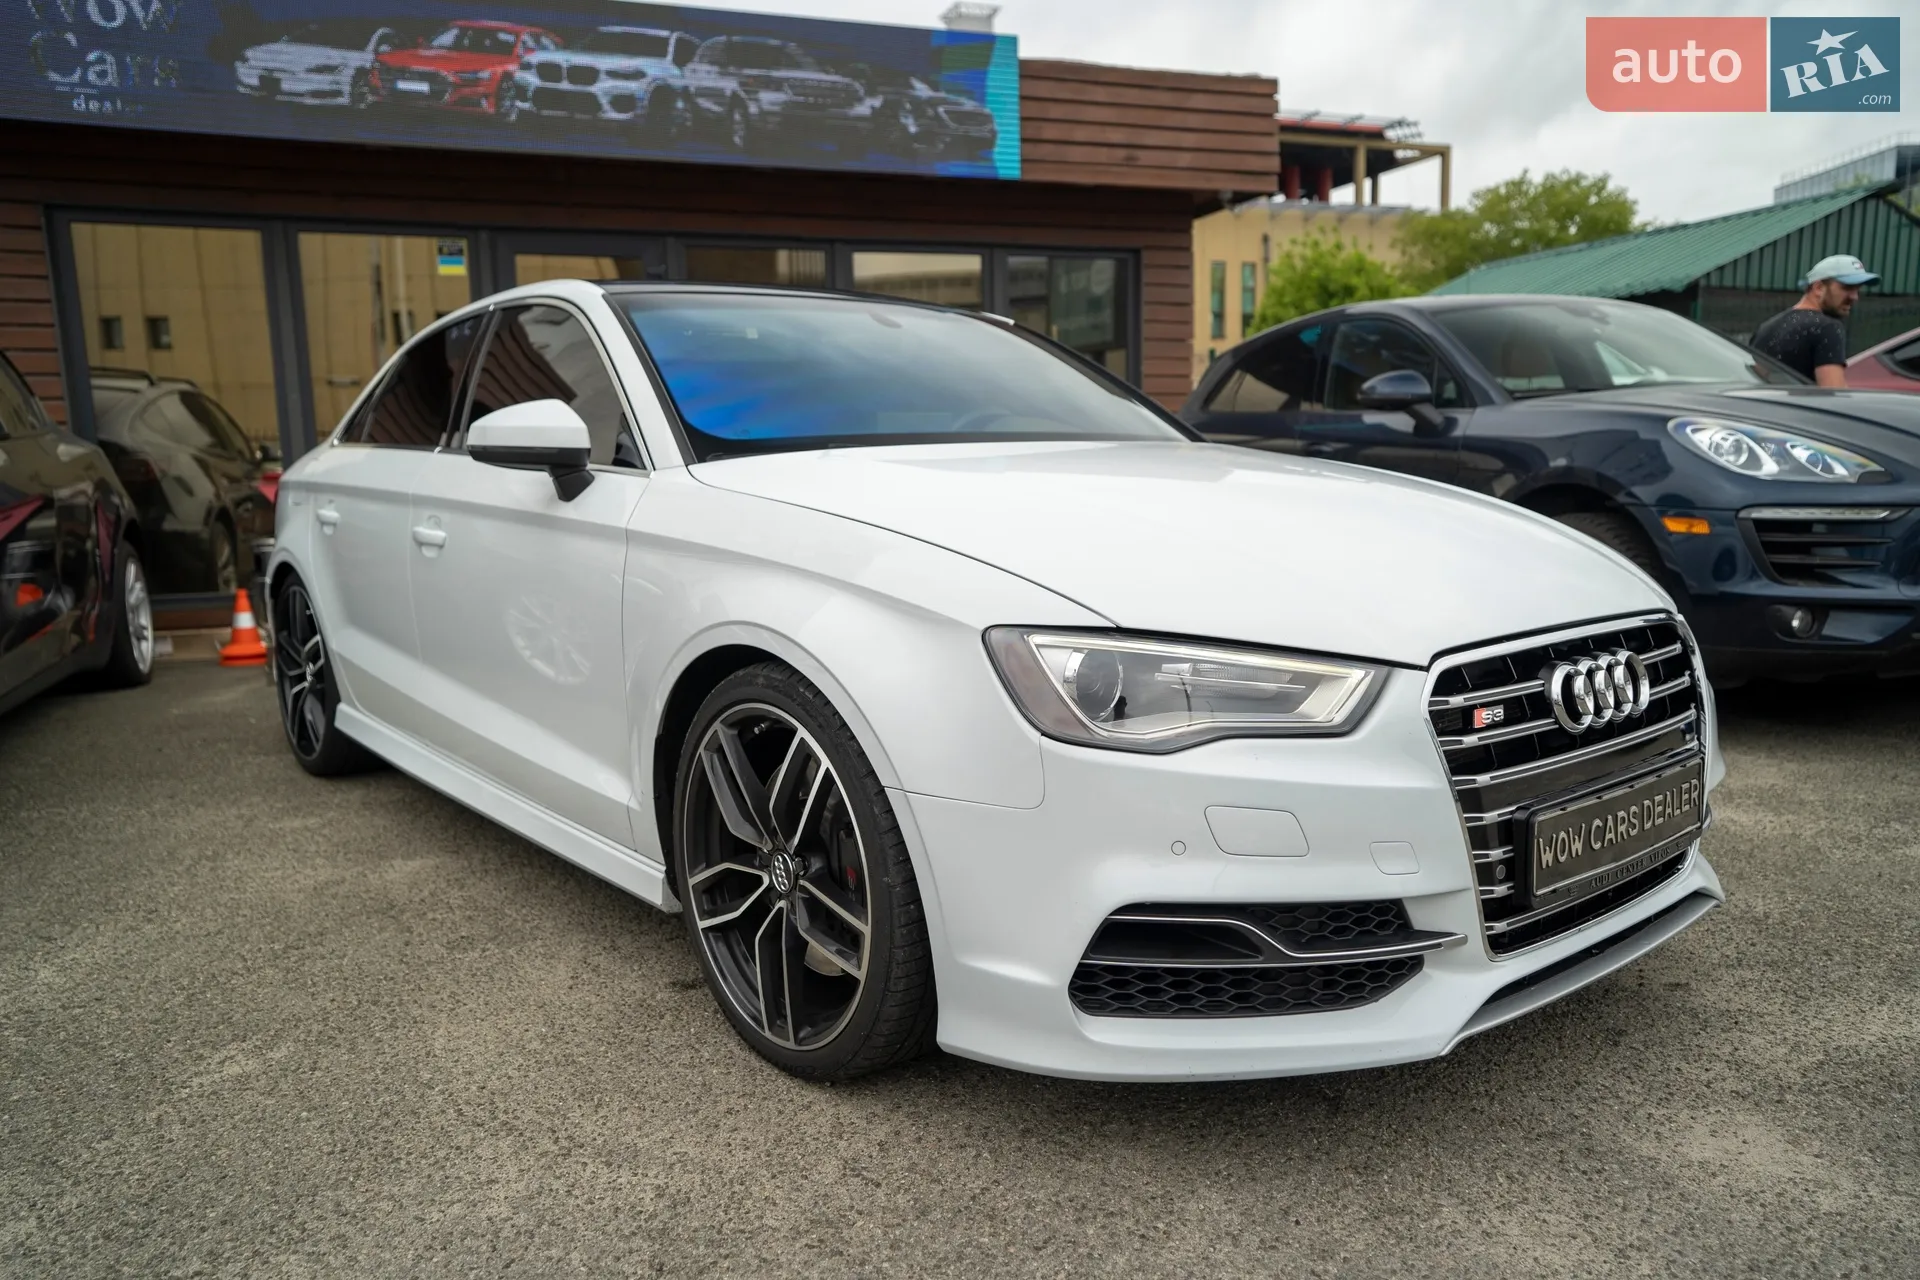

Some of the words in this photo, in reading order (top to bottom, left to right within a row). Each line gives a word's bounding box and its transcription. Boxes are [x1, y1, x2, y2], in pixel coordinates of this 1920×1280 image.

[1481, 709, 1504, 724] S3
[1538, 822, 1586, 869] WOW
[1590, 805, 1640, 850] CARS
[1643, 778, 1700, 831] DEALER
[1589, 873, 1612, 889] AUDI
[1615, 857, 1647, 879] CENTER
